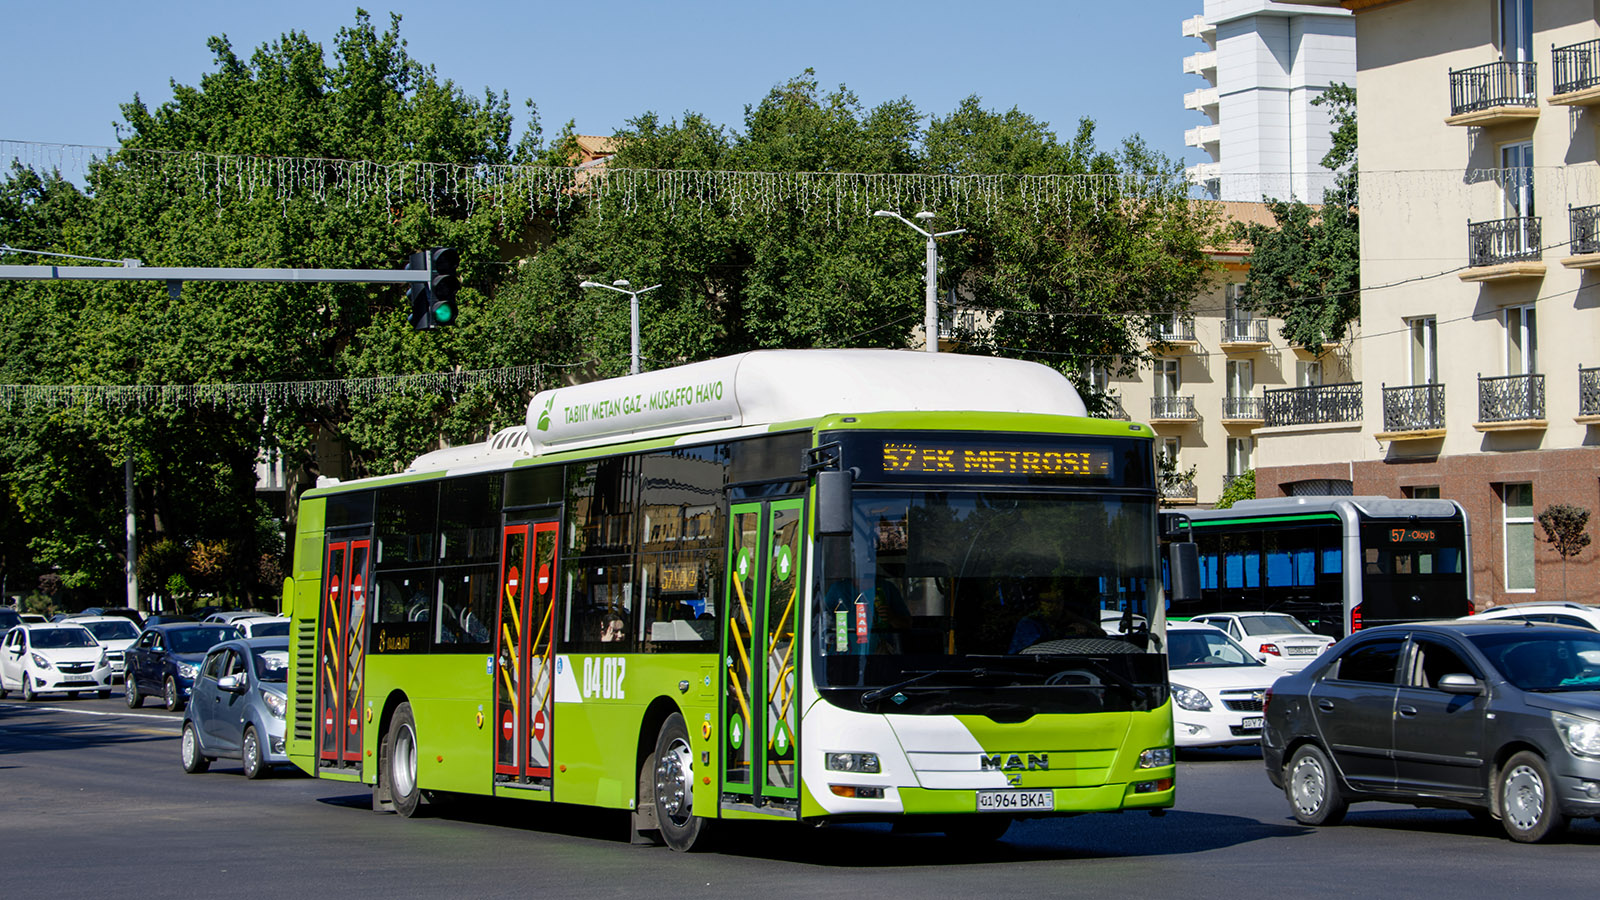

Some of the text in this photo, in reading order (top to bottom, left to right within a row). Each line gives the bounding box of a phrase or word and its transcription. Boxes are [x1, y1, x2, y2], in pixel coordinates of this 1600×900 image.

[591, 398, 621, 420] METAN
[622, 394, 641, 415] GAZ
[649, 385, 693, 411] MUSAFFO
[695, 380, 723, 404] HAVO
[883, 443, 917, 472] 57
[964, 449, 1091, 475] METROSI
[1391, 528, 1406, 542] 57
[980, 753, 1049, 771] MAN
[995, 793, 1018, 808] 964
[1020, 793, 1046, 807] BKA
